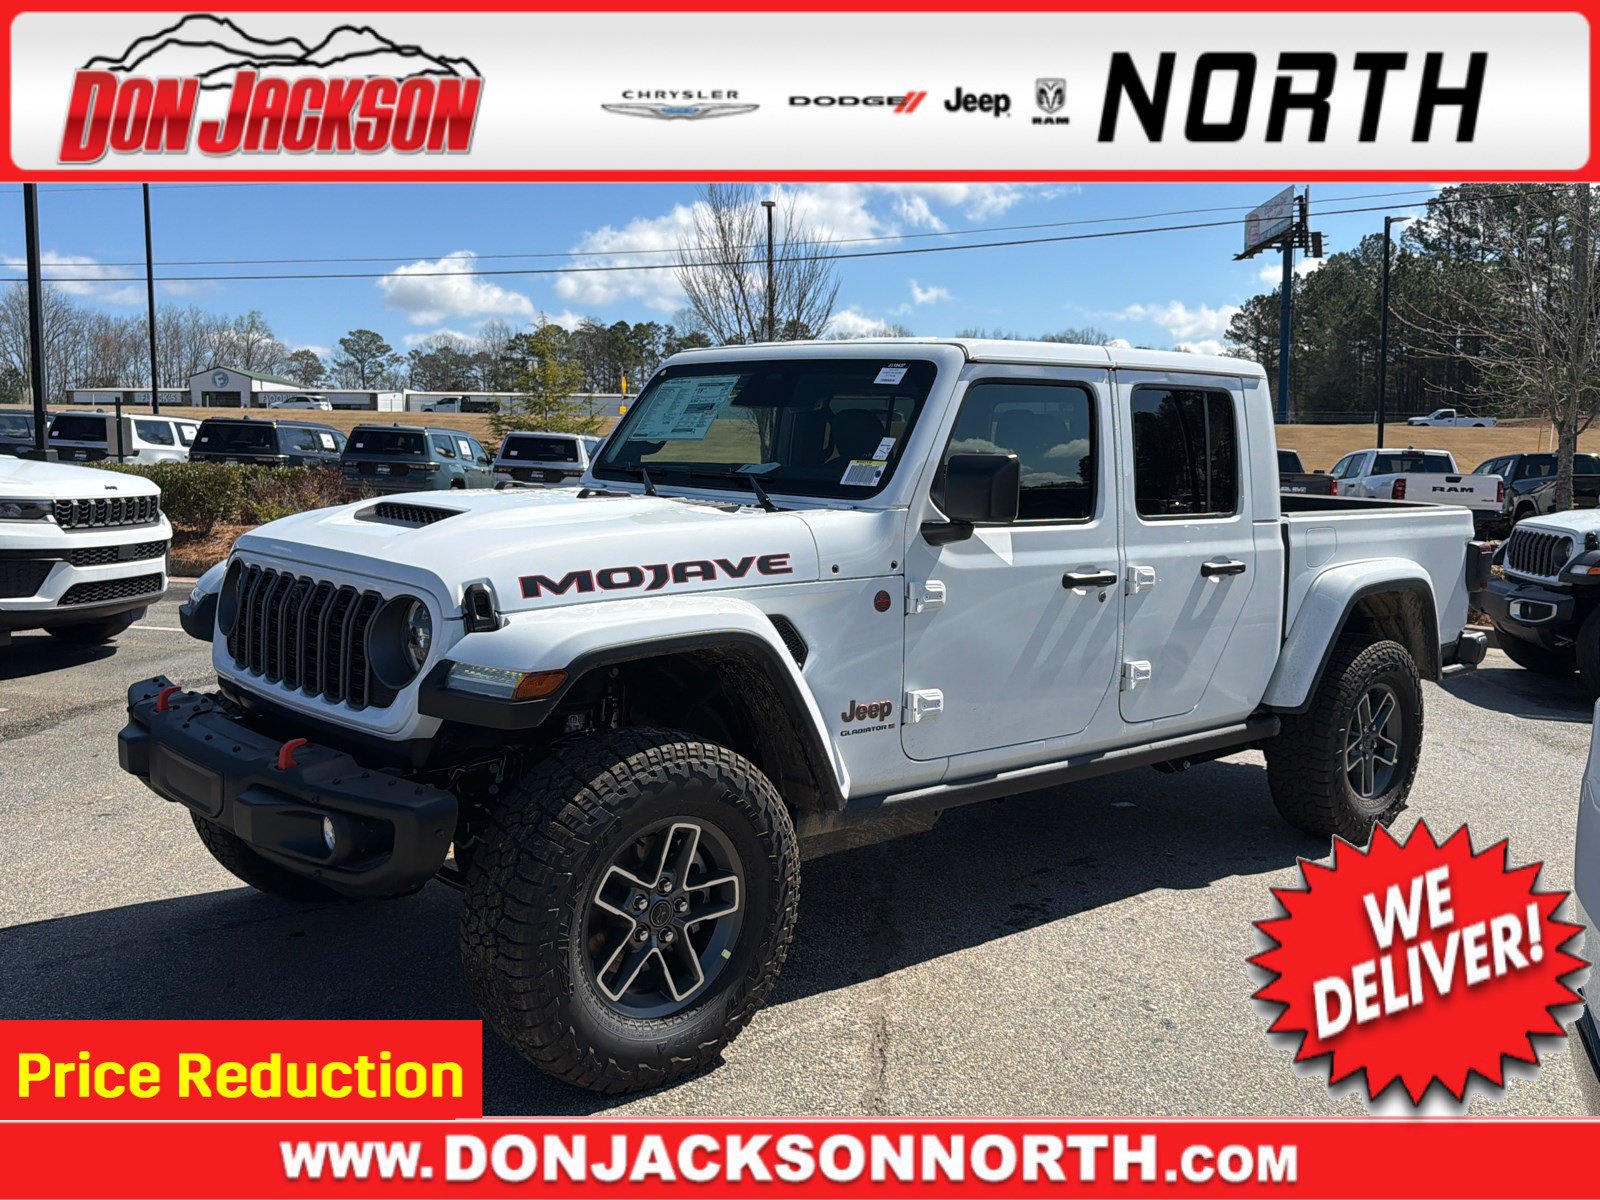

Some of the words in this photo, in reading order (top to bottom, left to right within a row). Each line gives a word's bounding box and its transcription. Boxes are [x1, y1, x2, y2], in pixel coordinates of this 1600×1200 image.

[518, 552, 794, 600] MOJAVE
[841, 699, 893, 723] Jeep
[840, 724, 888, 737] GLADIATOR
